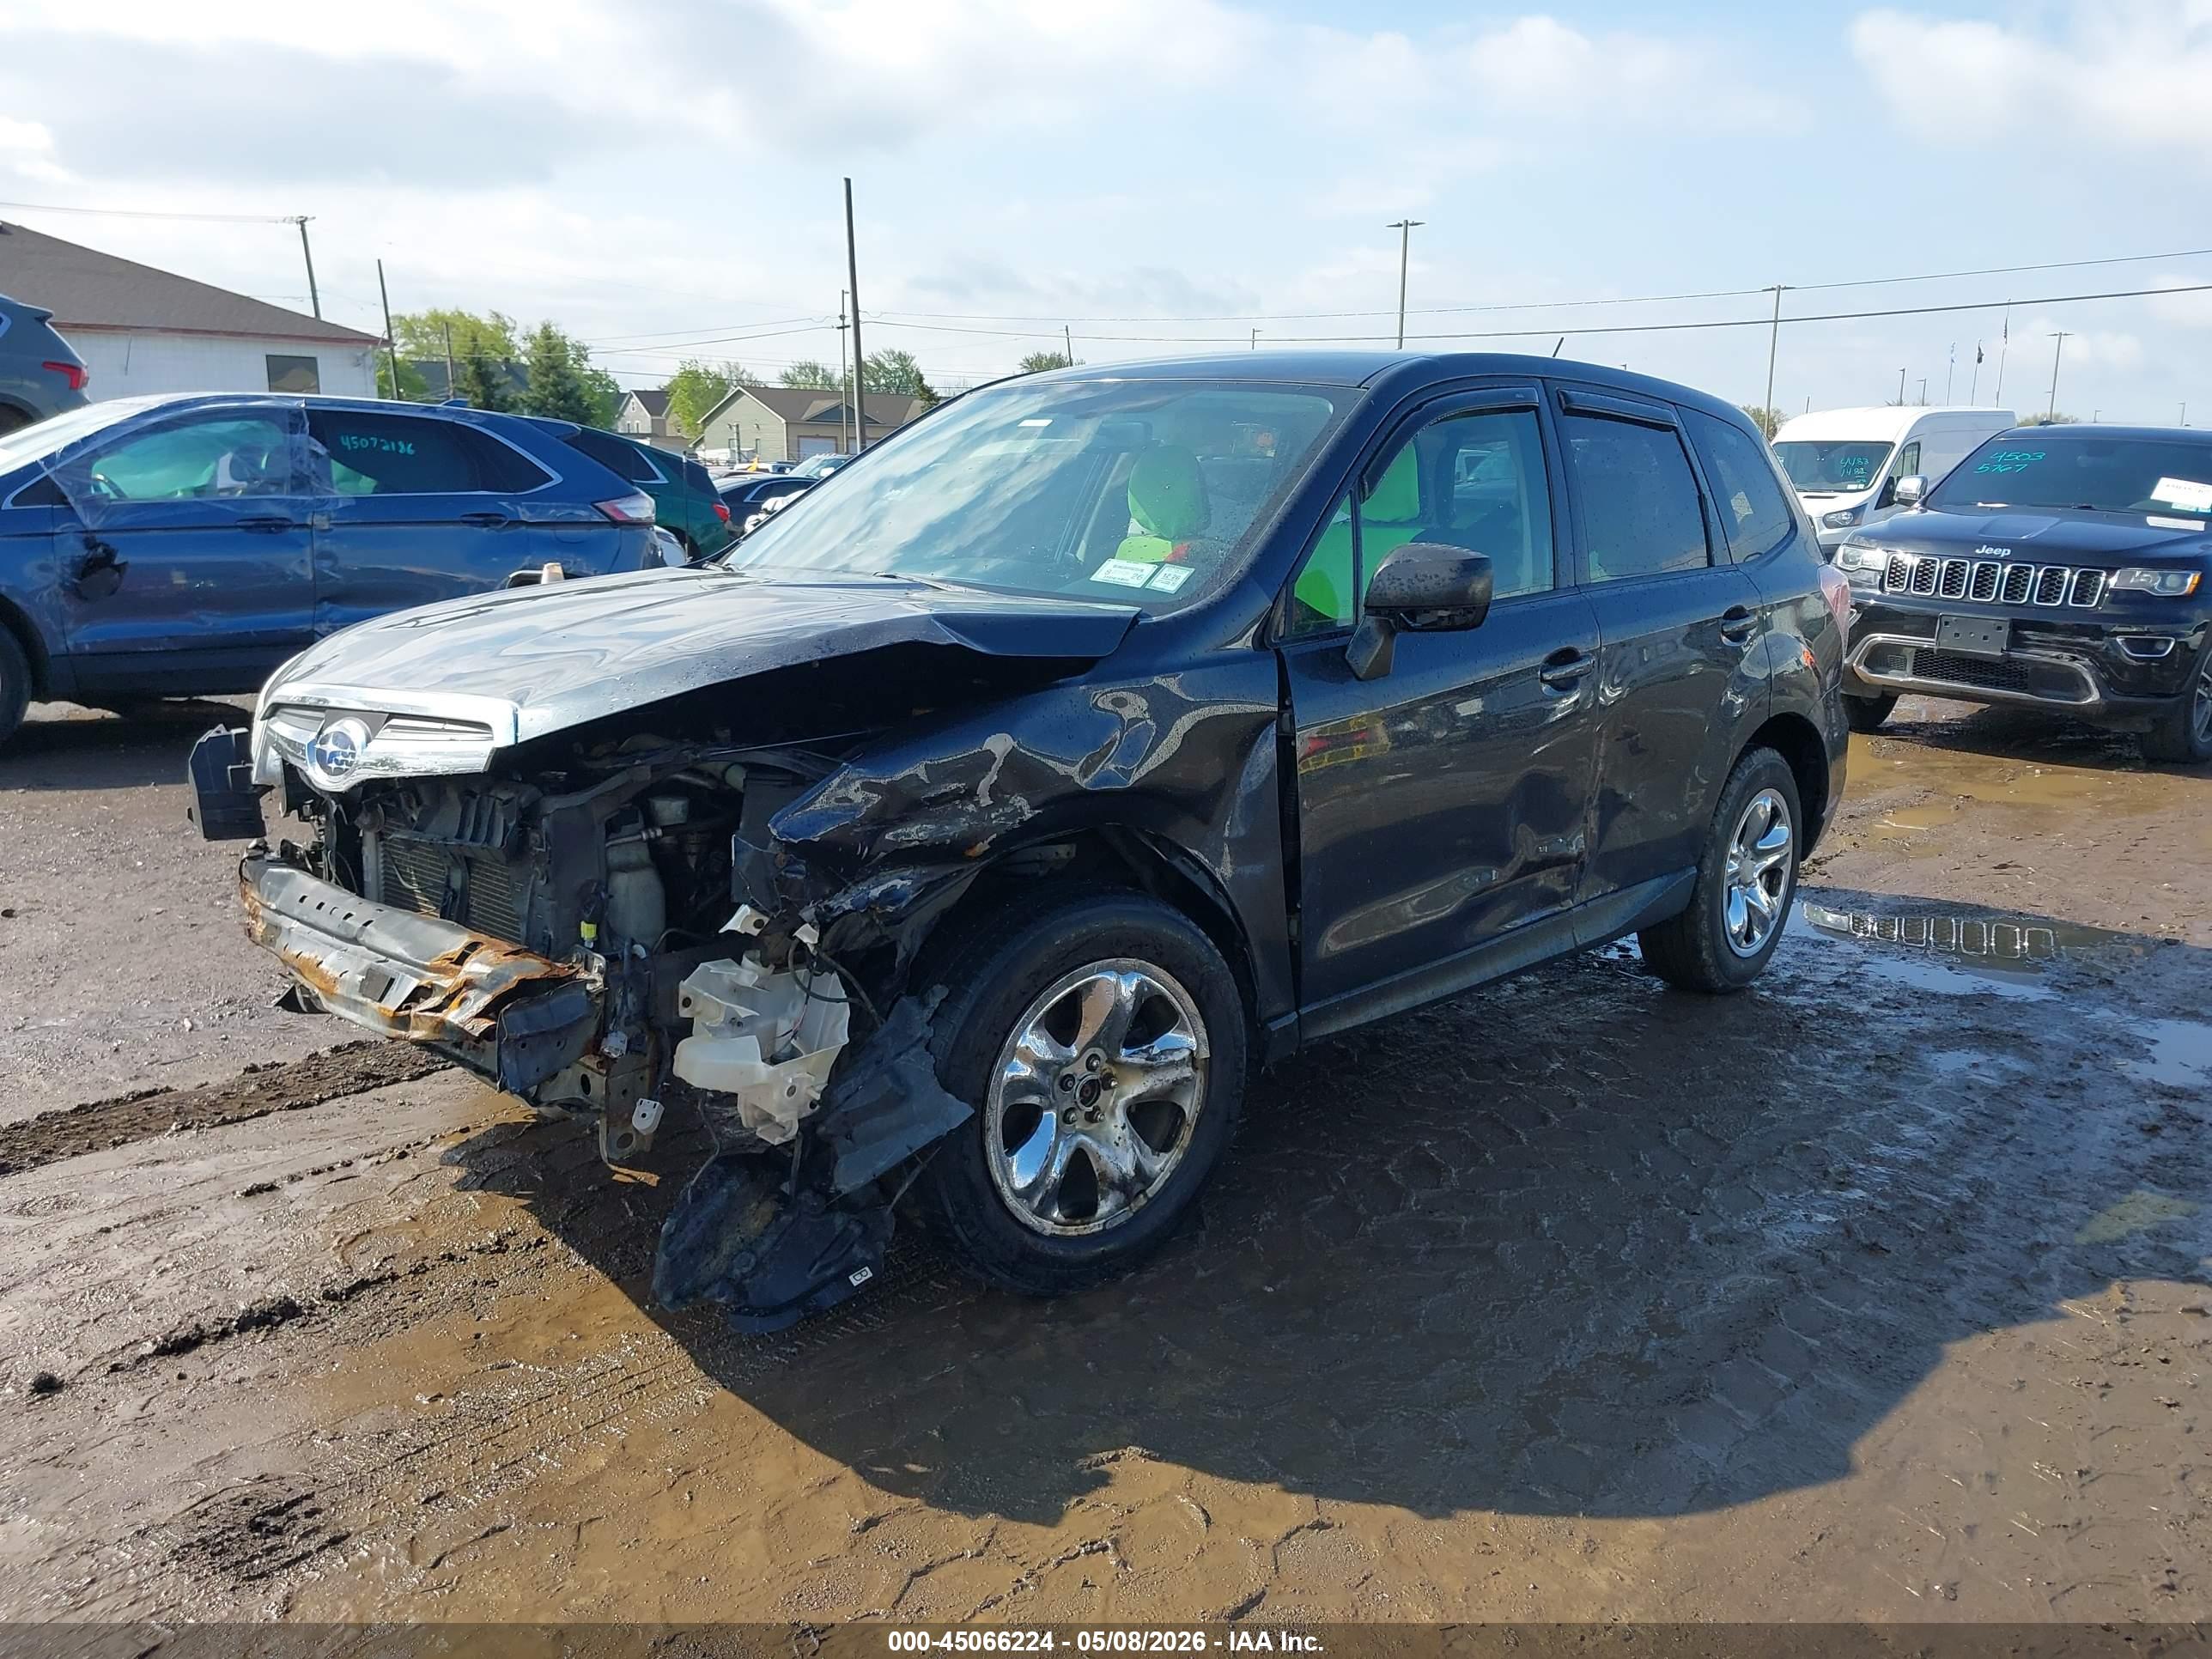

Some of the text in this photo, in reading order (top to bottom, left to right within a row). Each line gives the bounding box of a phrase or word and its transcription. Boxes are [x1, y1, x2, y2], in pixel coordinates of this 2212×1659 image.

[1990, 452, 2046, 463] 4503
[1972, 463, 2028, 474] 5767
[1975, 544, 2012, 557] Jeep
